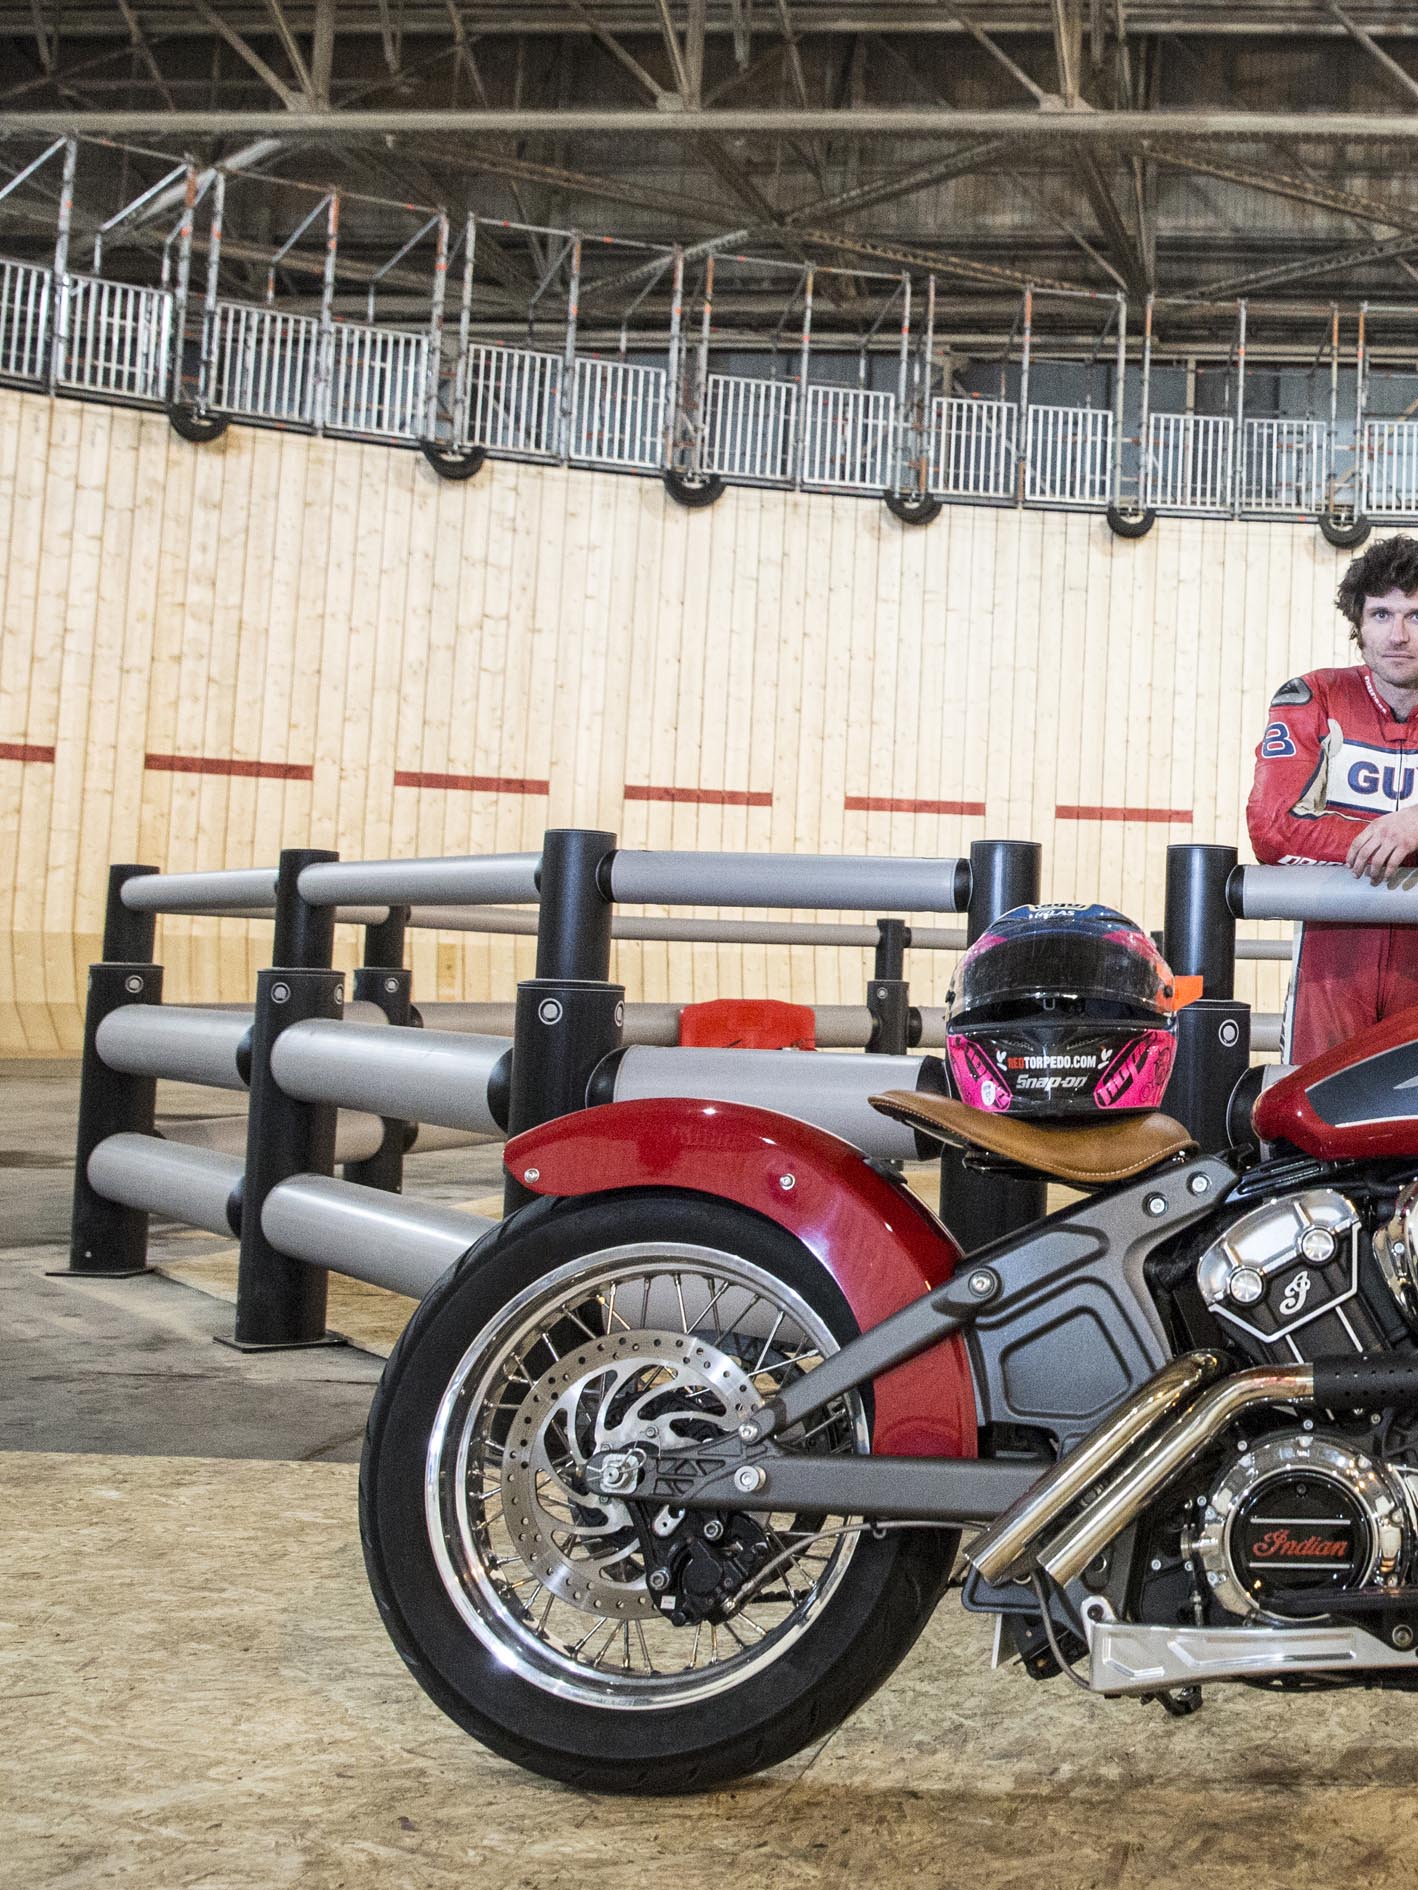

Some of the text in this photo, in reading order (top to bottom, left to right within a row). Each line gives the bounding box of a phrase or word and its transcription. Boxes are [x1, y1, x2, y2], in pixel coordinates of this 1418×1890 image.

[1007, 1055, 1097, 1070] REDTORPEDO.COM
[1016, 1074, 1090, 1092] Snap-on
[1252, 1528, 1348, 1558] Indian
